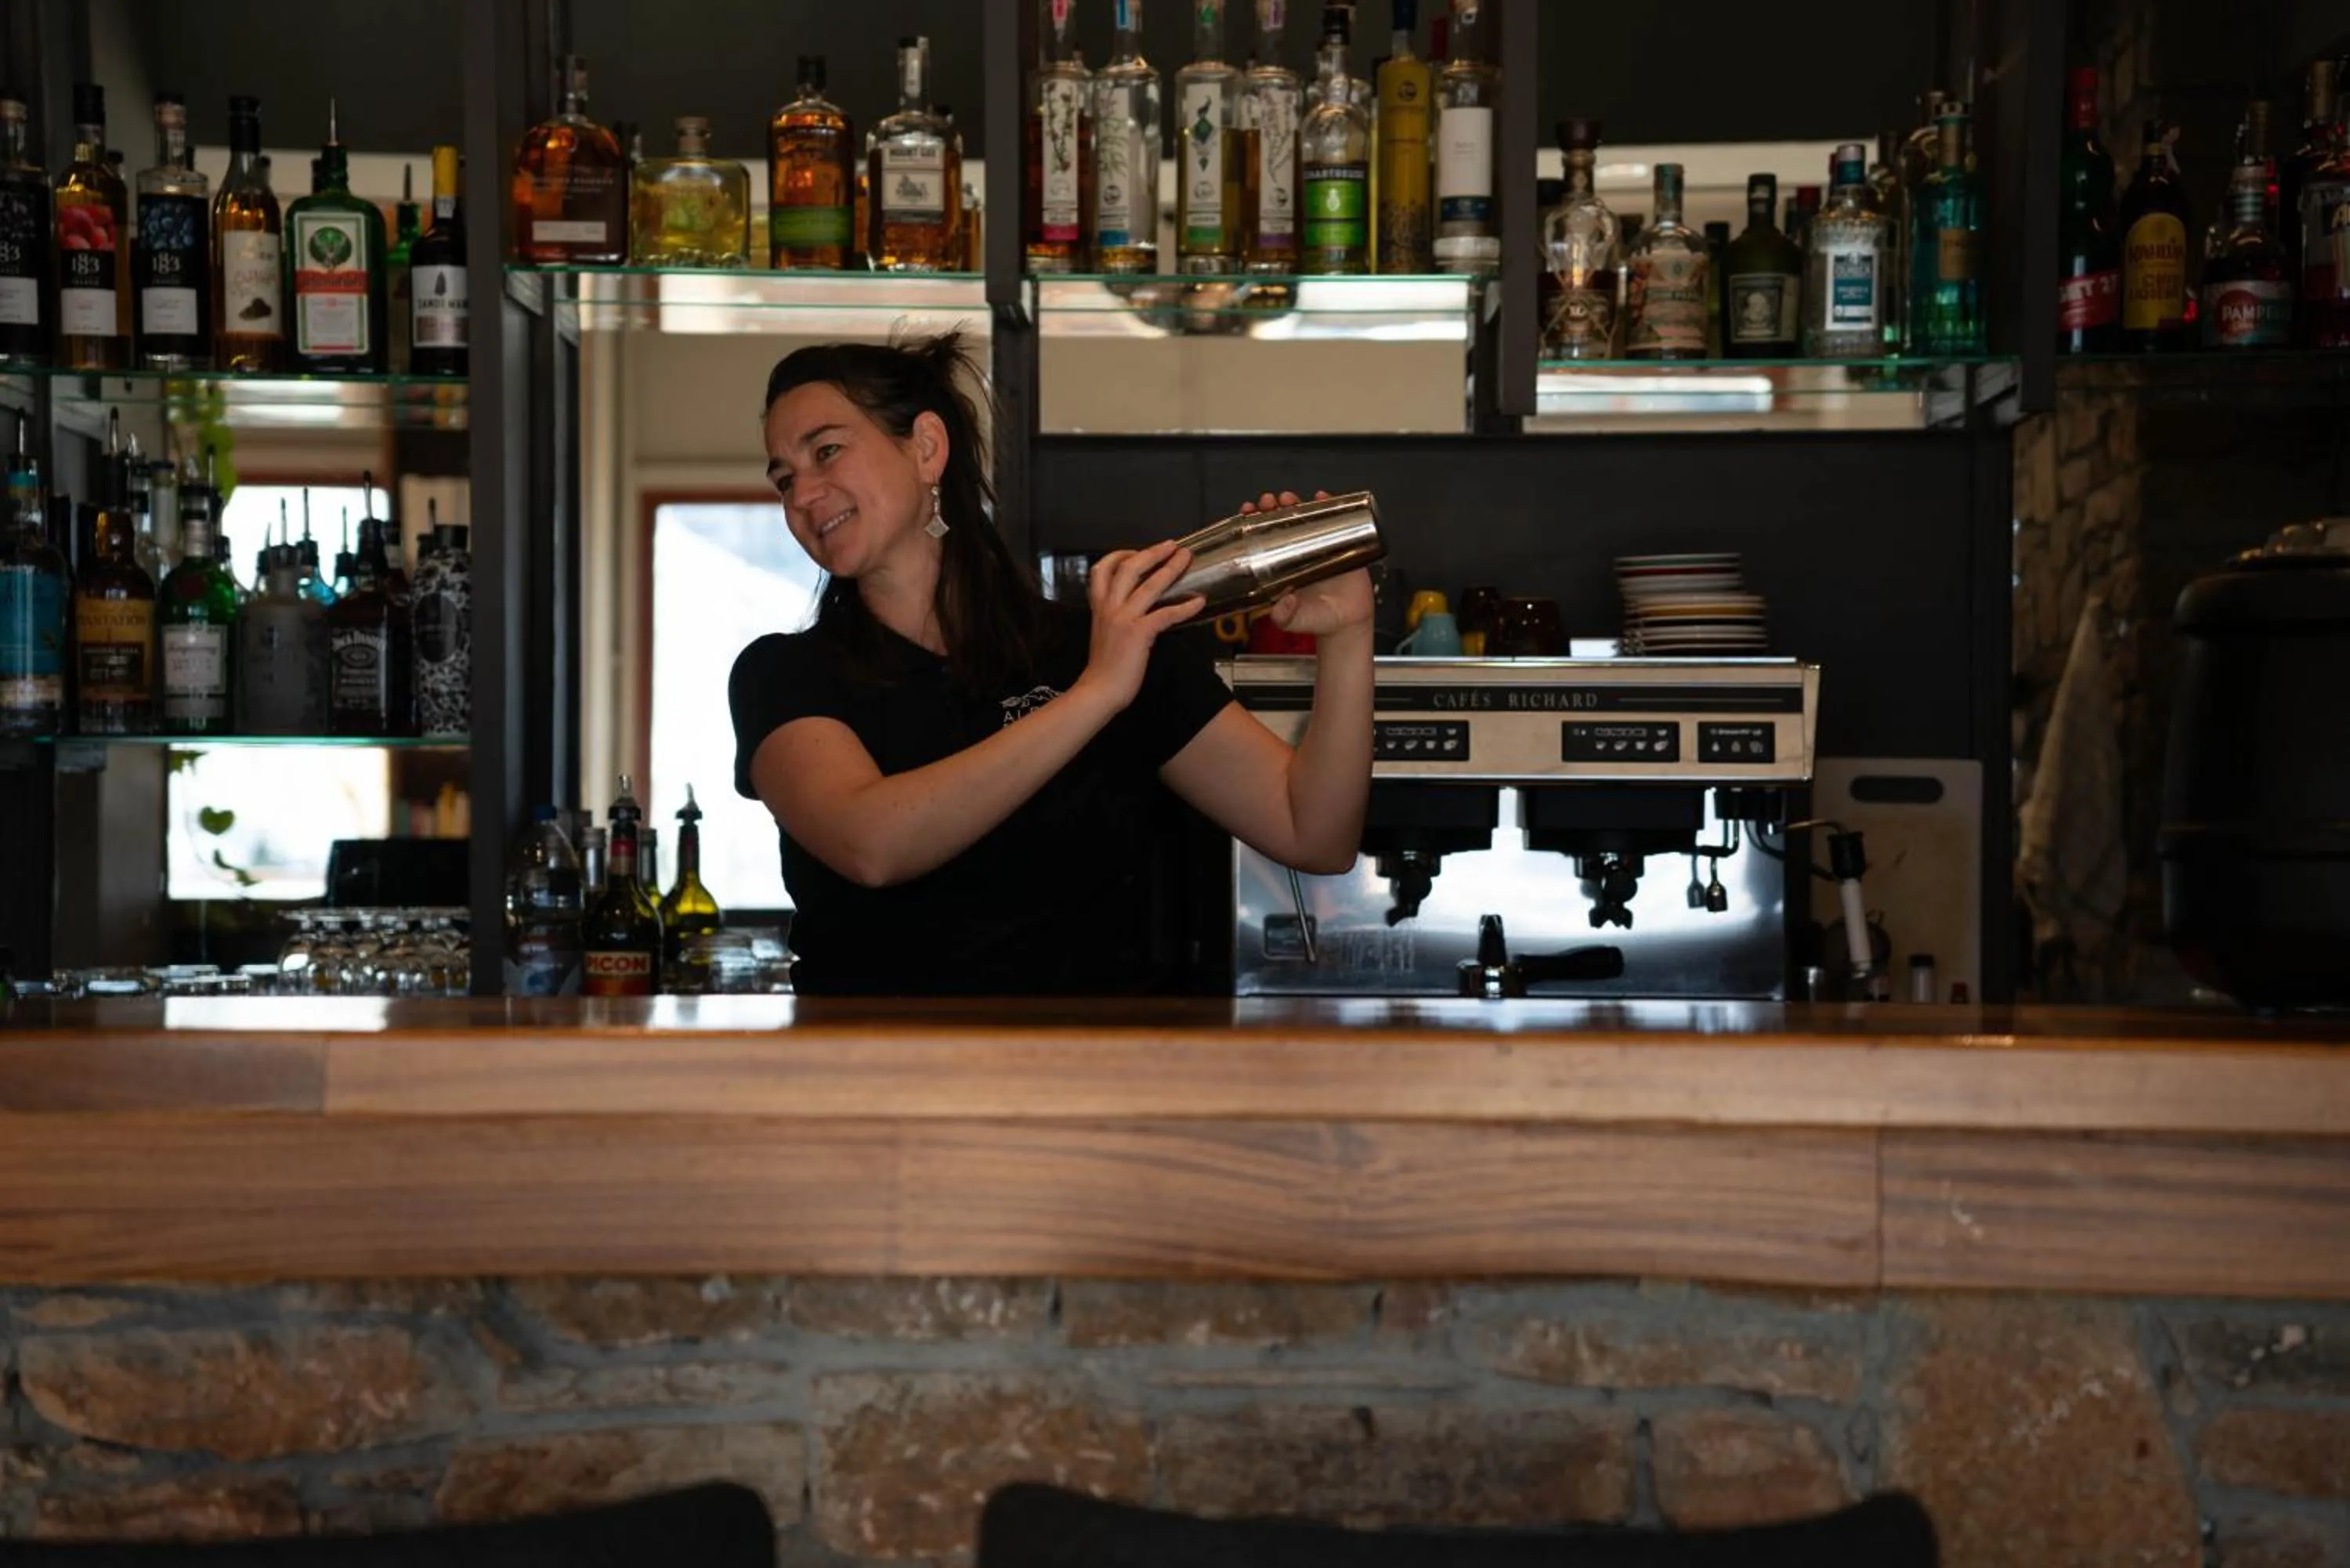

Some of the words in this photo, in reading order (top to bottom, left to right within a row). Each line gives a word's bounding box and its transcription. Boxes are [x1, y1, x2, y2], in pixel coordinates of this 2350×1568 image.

[1433, 690, 1492, 708] CAFÉS
[1508, 692, 1598, 709] RICHARD
[588, 956, 646, 972] PICON
